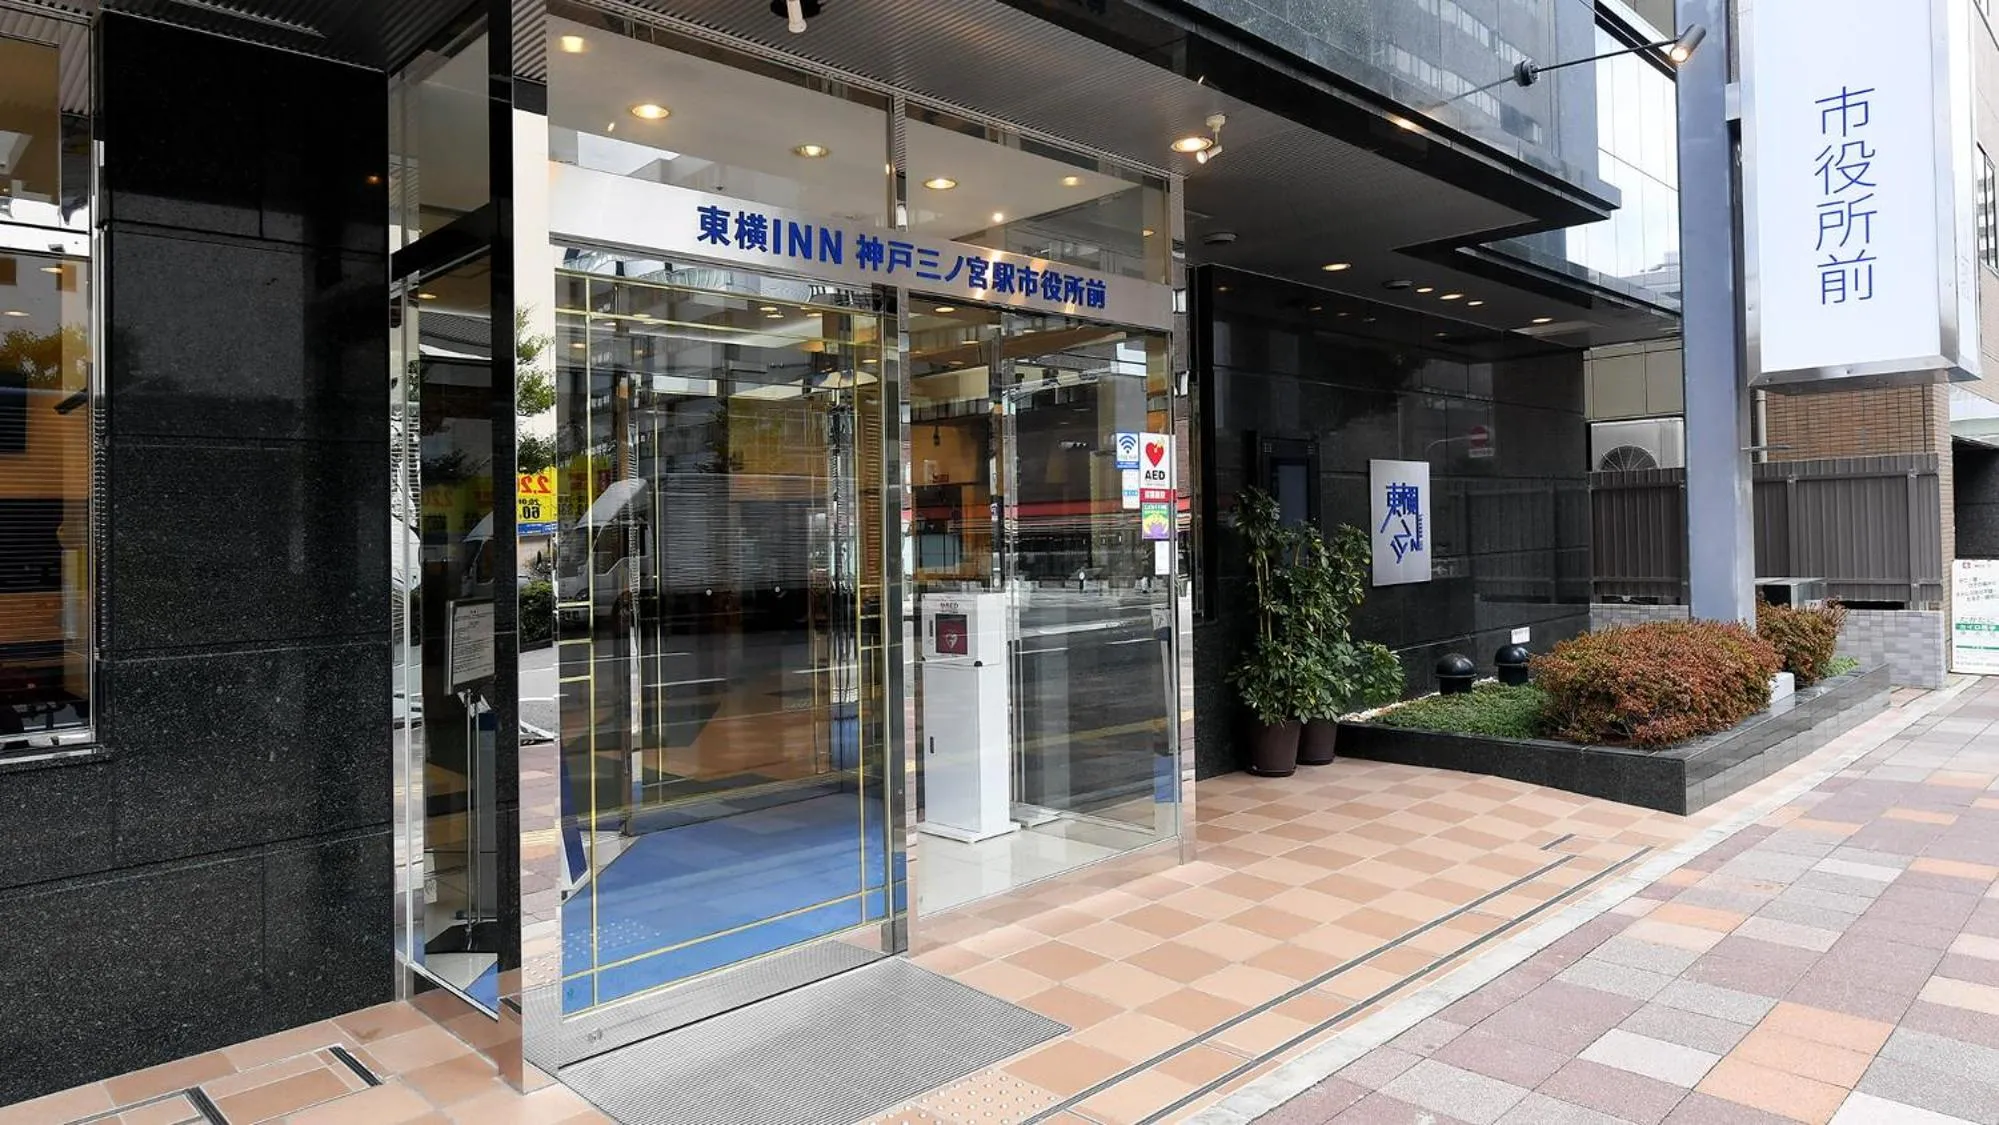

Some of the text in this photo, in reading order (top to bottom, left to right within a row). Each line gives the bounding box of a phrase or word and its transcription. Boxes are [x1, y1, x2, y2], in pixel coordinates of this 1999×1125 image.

[1815, 86, 1877, 305] 市役所前
[697, 206, 1106, 310] 東横INN 神戸三ノ宮駅市役所前
[1144, 469, 1166, 481] AED
